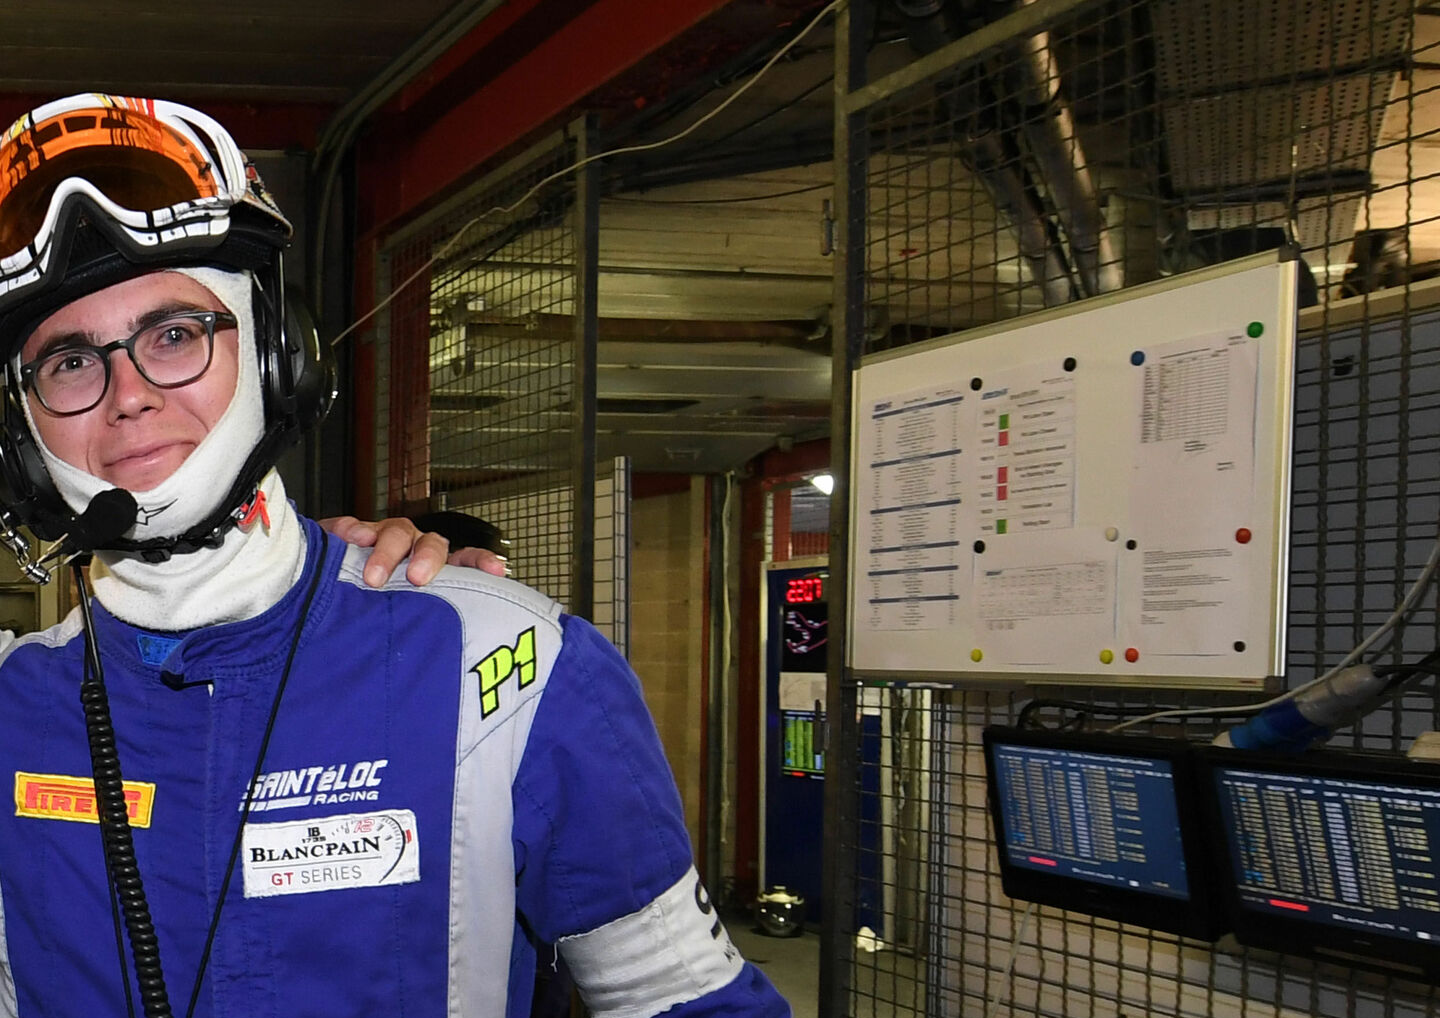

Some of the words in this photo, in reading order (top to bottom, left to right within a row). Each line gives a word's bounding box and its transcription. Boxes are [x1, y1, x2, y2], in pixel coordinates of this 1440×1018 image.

[467, 625, 537, 721] P1
[25, 782, 142, 818] PIREI
[313, 790, 379, 806] RACING
[250, 836, 381, 863] BLANCPAIN
[271, 872, 294, 887] GT
[301, 865, 363, 884] SERIES
